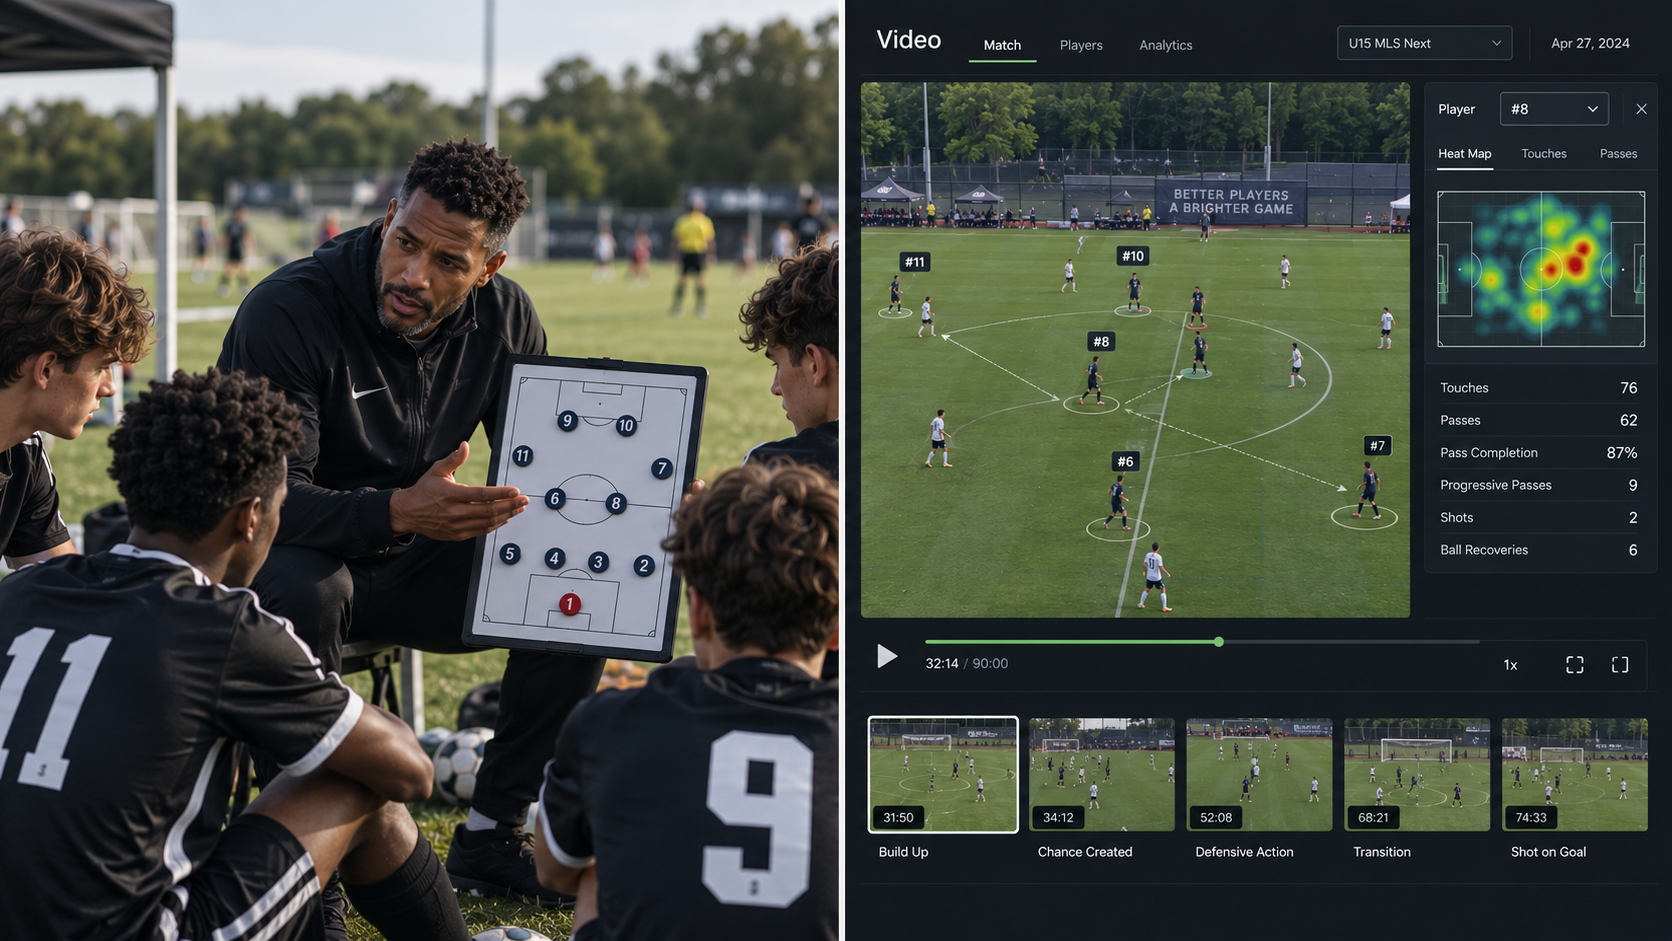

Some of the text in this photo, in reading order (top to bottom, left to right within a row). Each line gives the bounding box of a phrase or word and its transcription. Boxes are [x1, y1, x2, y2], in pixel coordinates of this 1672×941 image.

[876, 28, 942, 50] Video
[984, 39, 1022, 51] Match
[1349, 37, 1432, 49] U15 MLS Next
[1551, 37, 1630, 52] Apr 27, 2024
[1060, 39, 1104, 54] Players
[1139, 39, 1193, 54] Analytics
[1438, 103, 1476, 118] Player
[1511, 103, 1529, 115] #8
[1438, 148, 1492, 161] Heat Map
[1521, 148, 1568, 159] Touches
[1600, 148, 1638, 159] Passes
[1174, 188, 1289, 201] BETTER PLAYERS
[1168, 202, 1294, 215] A BRIGHTER GAME
[904, 256, 925, 268] #11
[1122, 250, 1145, 262] #10
[1093, 336, 1110, 348] #8
[1440, 381, 1489, 394] Touches
[1620, 381, 1638, 395] 76
[563, 415, 572, 427] 9
[619, 420, 633, 432] 10
[1440, 414, 1481, 426] Passes
[1620, 413, 1638, 427] 62
[1370, 440, 1386, 451] #7
[516, 450, 529, 463] 11
[1440, 446, 1538, 461] Pass Completion
[1606, 446, 1638, 460] 87%
[1117, 455, 1134, 468] #6
[658, 462, 667, 475] 7
[1440, 479, 1553, 493] Progressive Passes
[1628, 478, 1638, 492] 9
[550, 492, 560, 505] 6
[612, 497, 621, 510] 8
[1440, 511, 1474, 523] Shots
[1629, 511, 1638, 524] 2
[505, 548, 514, 560] 5
[1440, 543, 1529, 556] Ball Recoveries
[1628, 543, 1638, 557] 6
[549, 553, 559, 564] 4
[594, 556, 603, 568] 3
[639, 560, 649, 572] 2
[566, 597, 573, 610] 1
[925, 657, 959, 669] 32:14
[972, 657, 1009, 669] 90:00
[1503, 658, 1518, 671] 1x
[0, 627, 112, 791] 11
[701, 729, 814, 908] 9
[883, 812, 914, 823] 31:50
[1043, 812, 1074, 823] 34:12
[1200, 812, 1233, 823] 52:08
[1358, 812, 1389, 823] 68:21
[1515, 812, 1548, 823] 74:33
[879, 846, 929, 860] Build Up
[1037, 845, 1133, 858] Chance Created
[1195, 845, 1294, 858] Defensive Action
[1353, 846, 1411, 858] Transition
[1511, 846, 1587, 858] Shot on Goal
